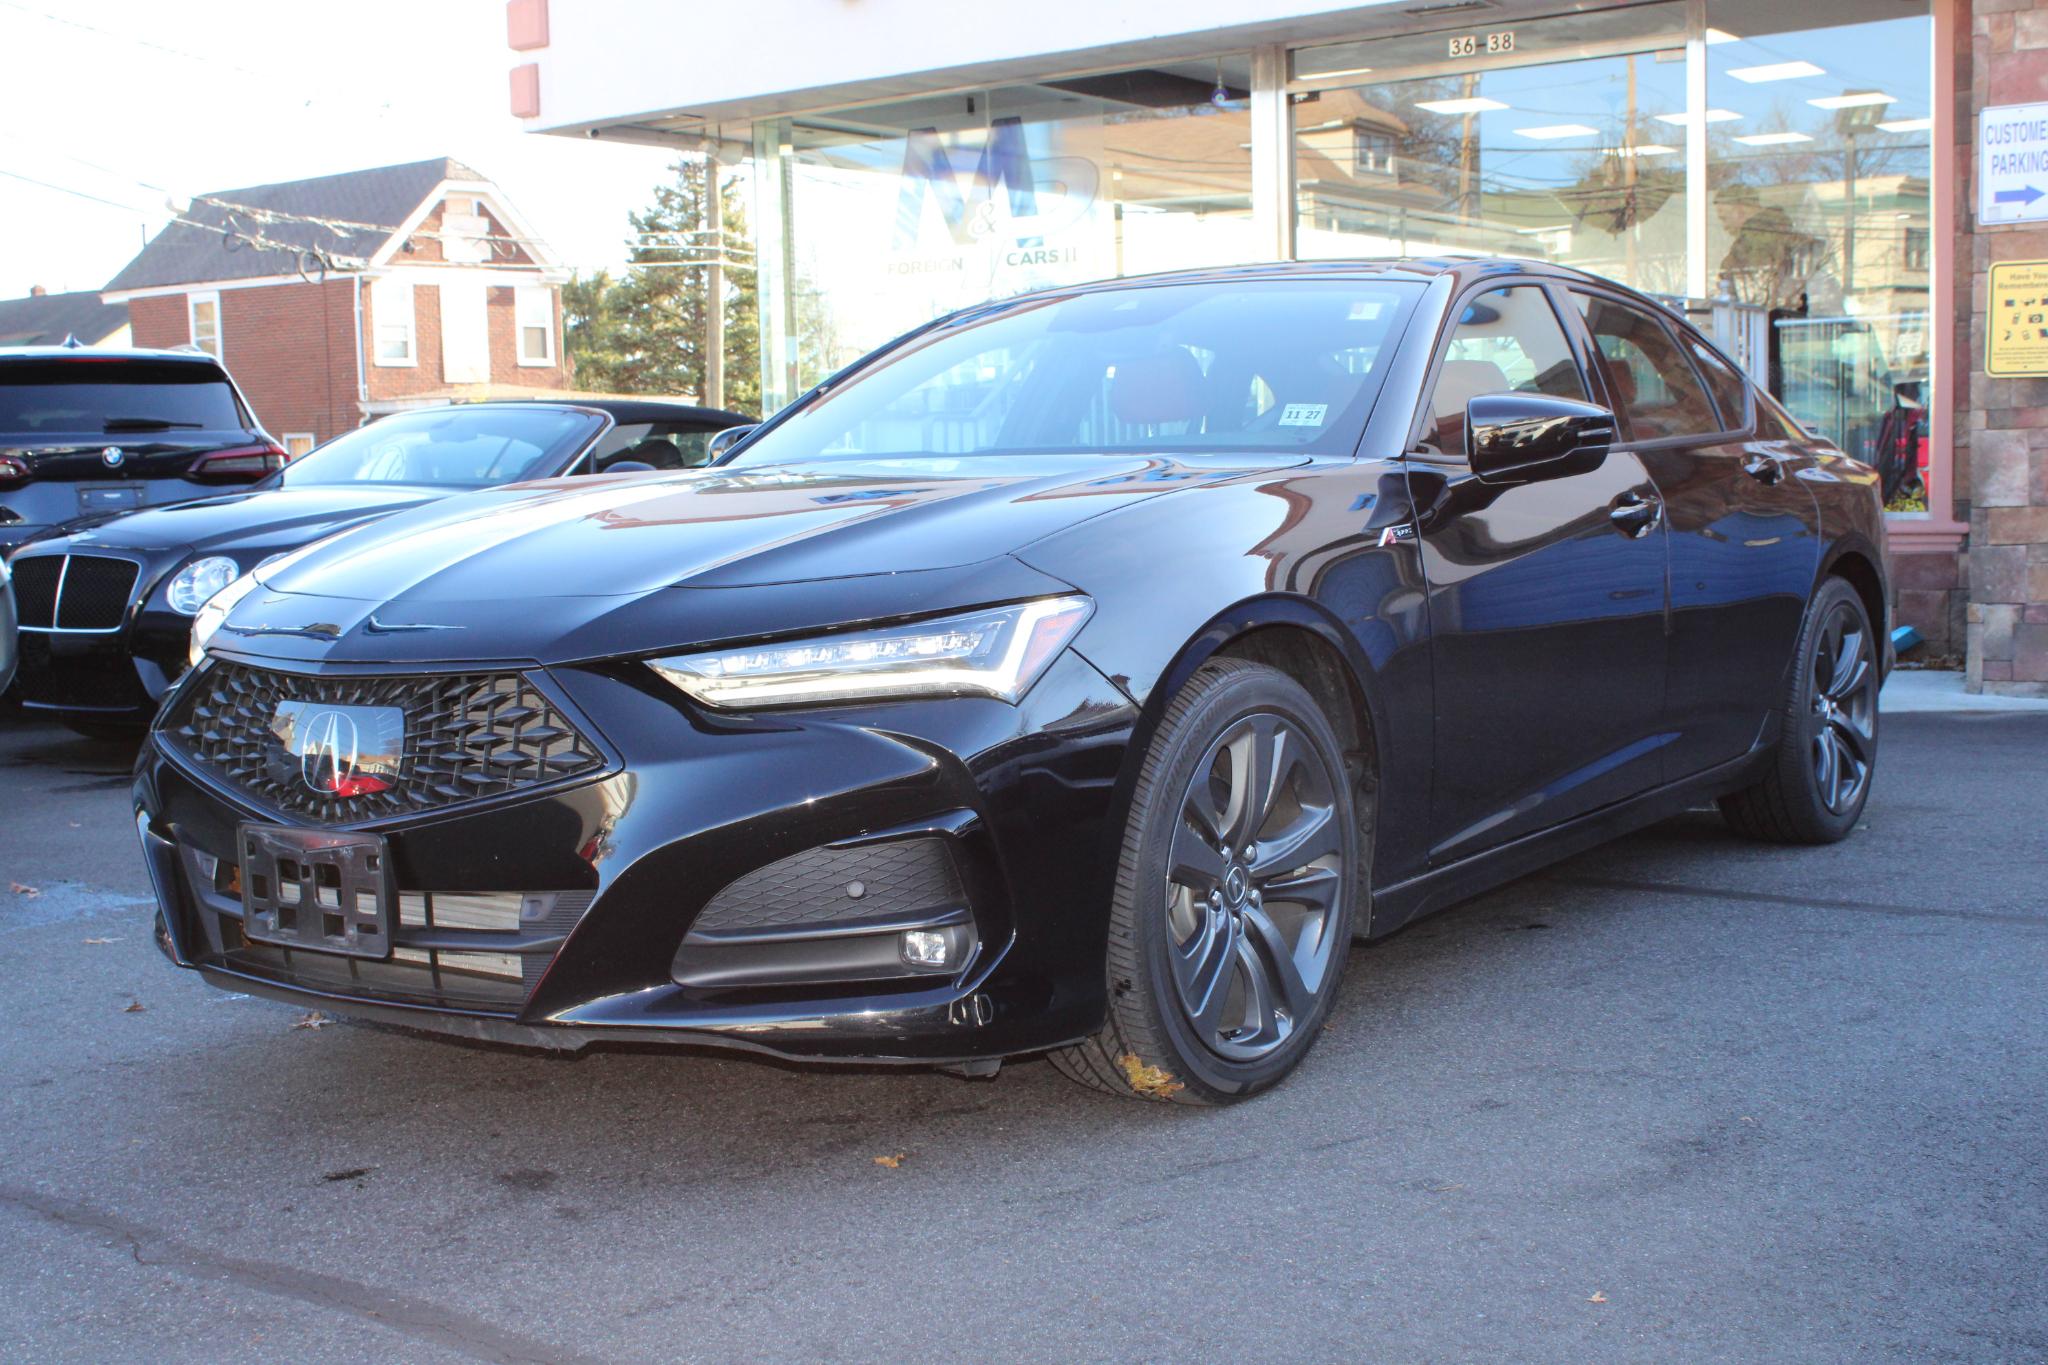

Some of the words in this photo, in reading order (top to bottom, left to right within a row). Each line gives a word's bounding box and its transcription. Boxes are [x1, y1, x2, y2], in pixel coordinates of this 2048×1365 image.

[1991, 149, 2048, 176] PARKING
[888, 258, 963, 276] FOREIGN
[1006, 249, 1059, 267] CARS
[1285, 410, 1300, 420] 11
[1304, 410, 1321, 420] 27
